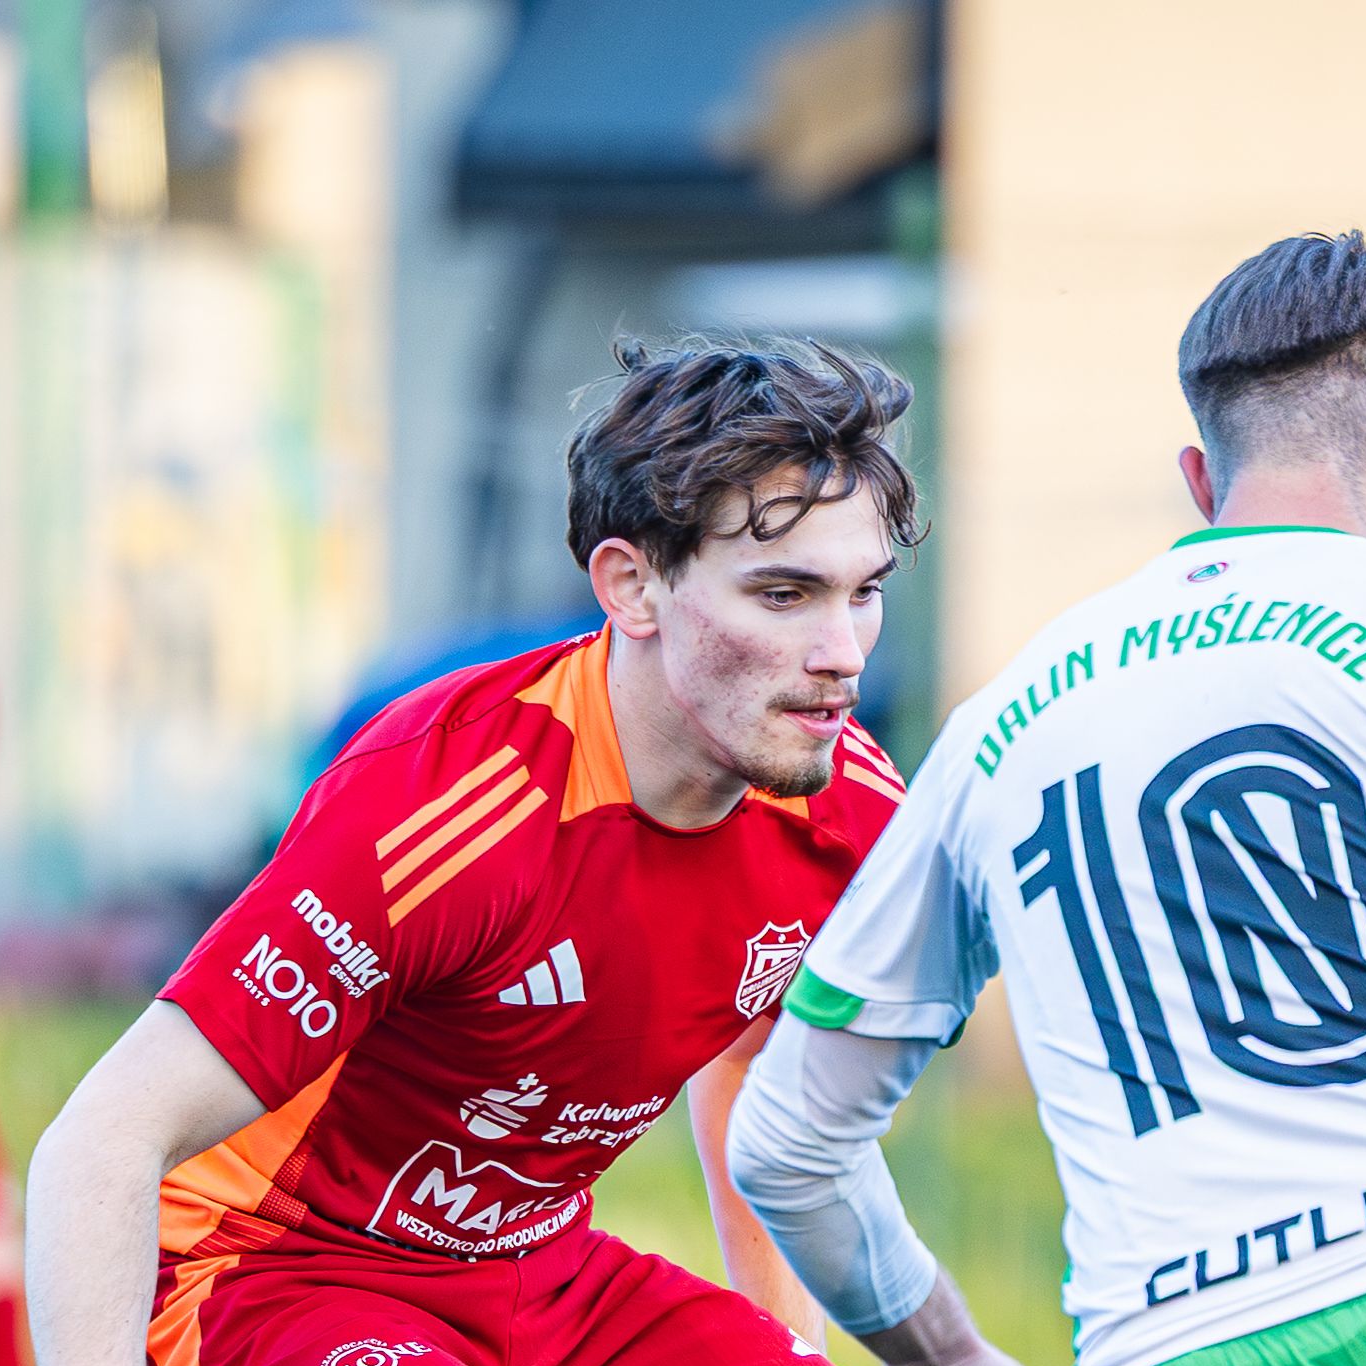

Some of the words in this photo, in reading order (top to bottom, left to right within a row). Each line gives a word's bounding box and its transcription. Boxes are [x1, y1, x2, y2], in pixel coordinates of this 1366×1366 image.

[973, 641, 1095, 780] DALIN
[290, 888, 391, 992] mobilki
[232, 967, 271, 1007] SPORTS
[240, 933, 338, 1039] NO10
[558, 1095, 666, 1122] Kalwaria
[541, 1119, 656, 1149] Zebrzydo
[395, 1209, 475, 1253] WSZYSTKO
[473, 1238, 496, 1254] DO
[496, 1215, 561, 1252] PRODUKCJI
